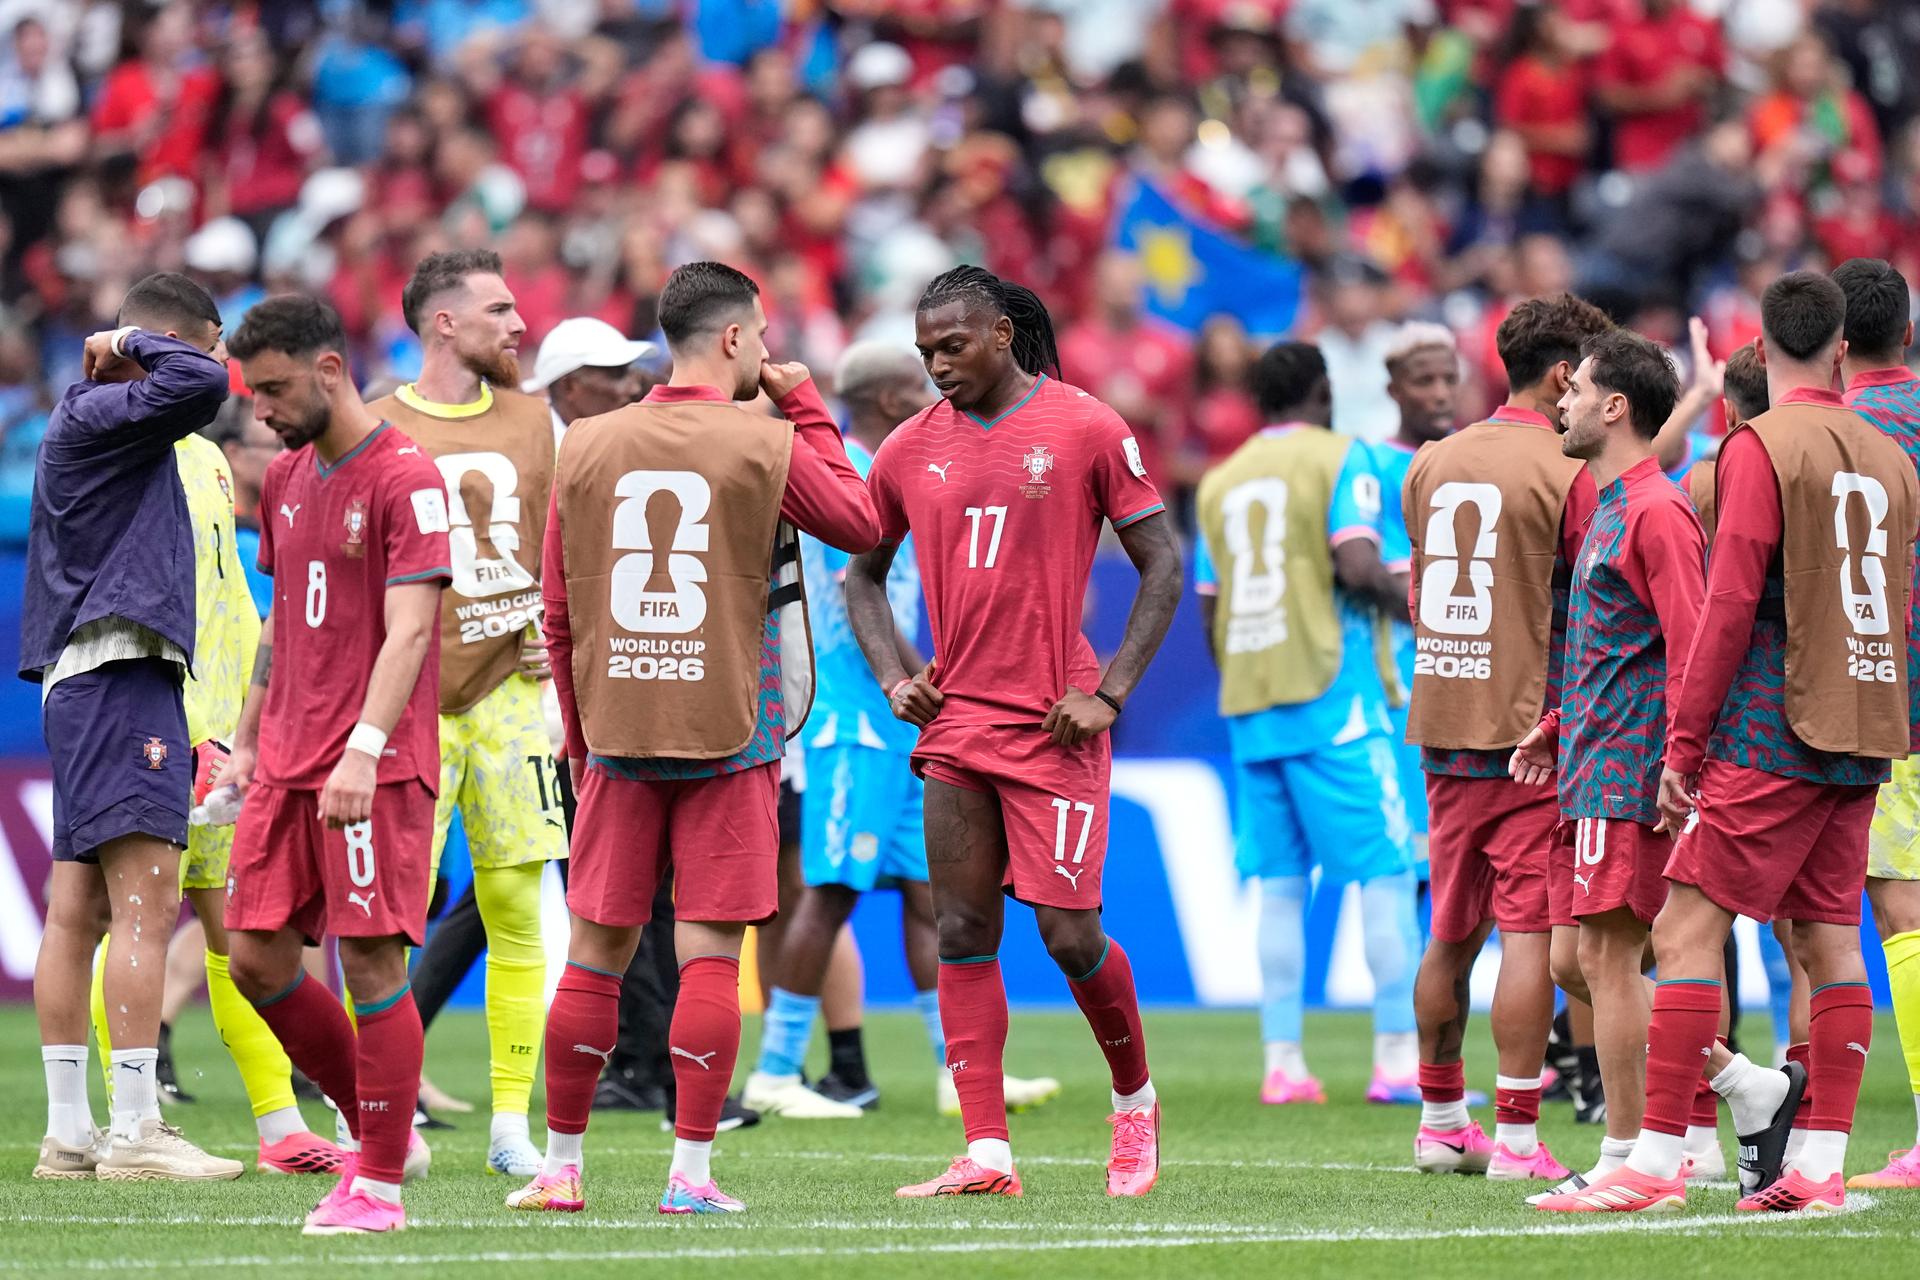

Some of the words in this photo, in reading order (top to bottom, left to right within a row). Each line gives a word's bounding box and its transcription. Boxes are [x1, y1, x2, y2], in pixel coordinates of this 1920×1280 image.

[965, 506, 1008, 568] 17
[475, 565, 512, 582] FIFA
[305, 560, 327, 628] 8
[456, 598, 511, 620] WORLD
[639, 601, 680, 617] FIFA
[1446, 604, 1478, 620] FIFA
[609, 638, 668, 654] WORLD
[671, 640, 705, 655] CUP
[1416, 637, 1468, 654] WORLD
[1470, 641, 1492, 655] CUP
[608, 655, 704, 681] 2026
[1414, 653, 1491, 680] 2026
[1051, 798, 1095, 863] 17
[1574, 817, 1607, 868] 10
[344, 819, 375, 887] 8
[56, 1150, 84, 1164] PUMA
